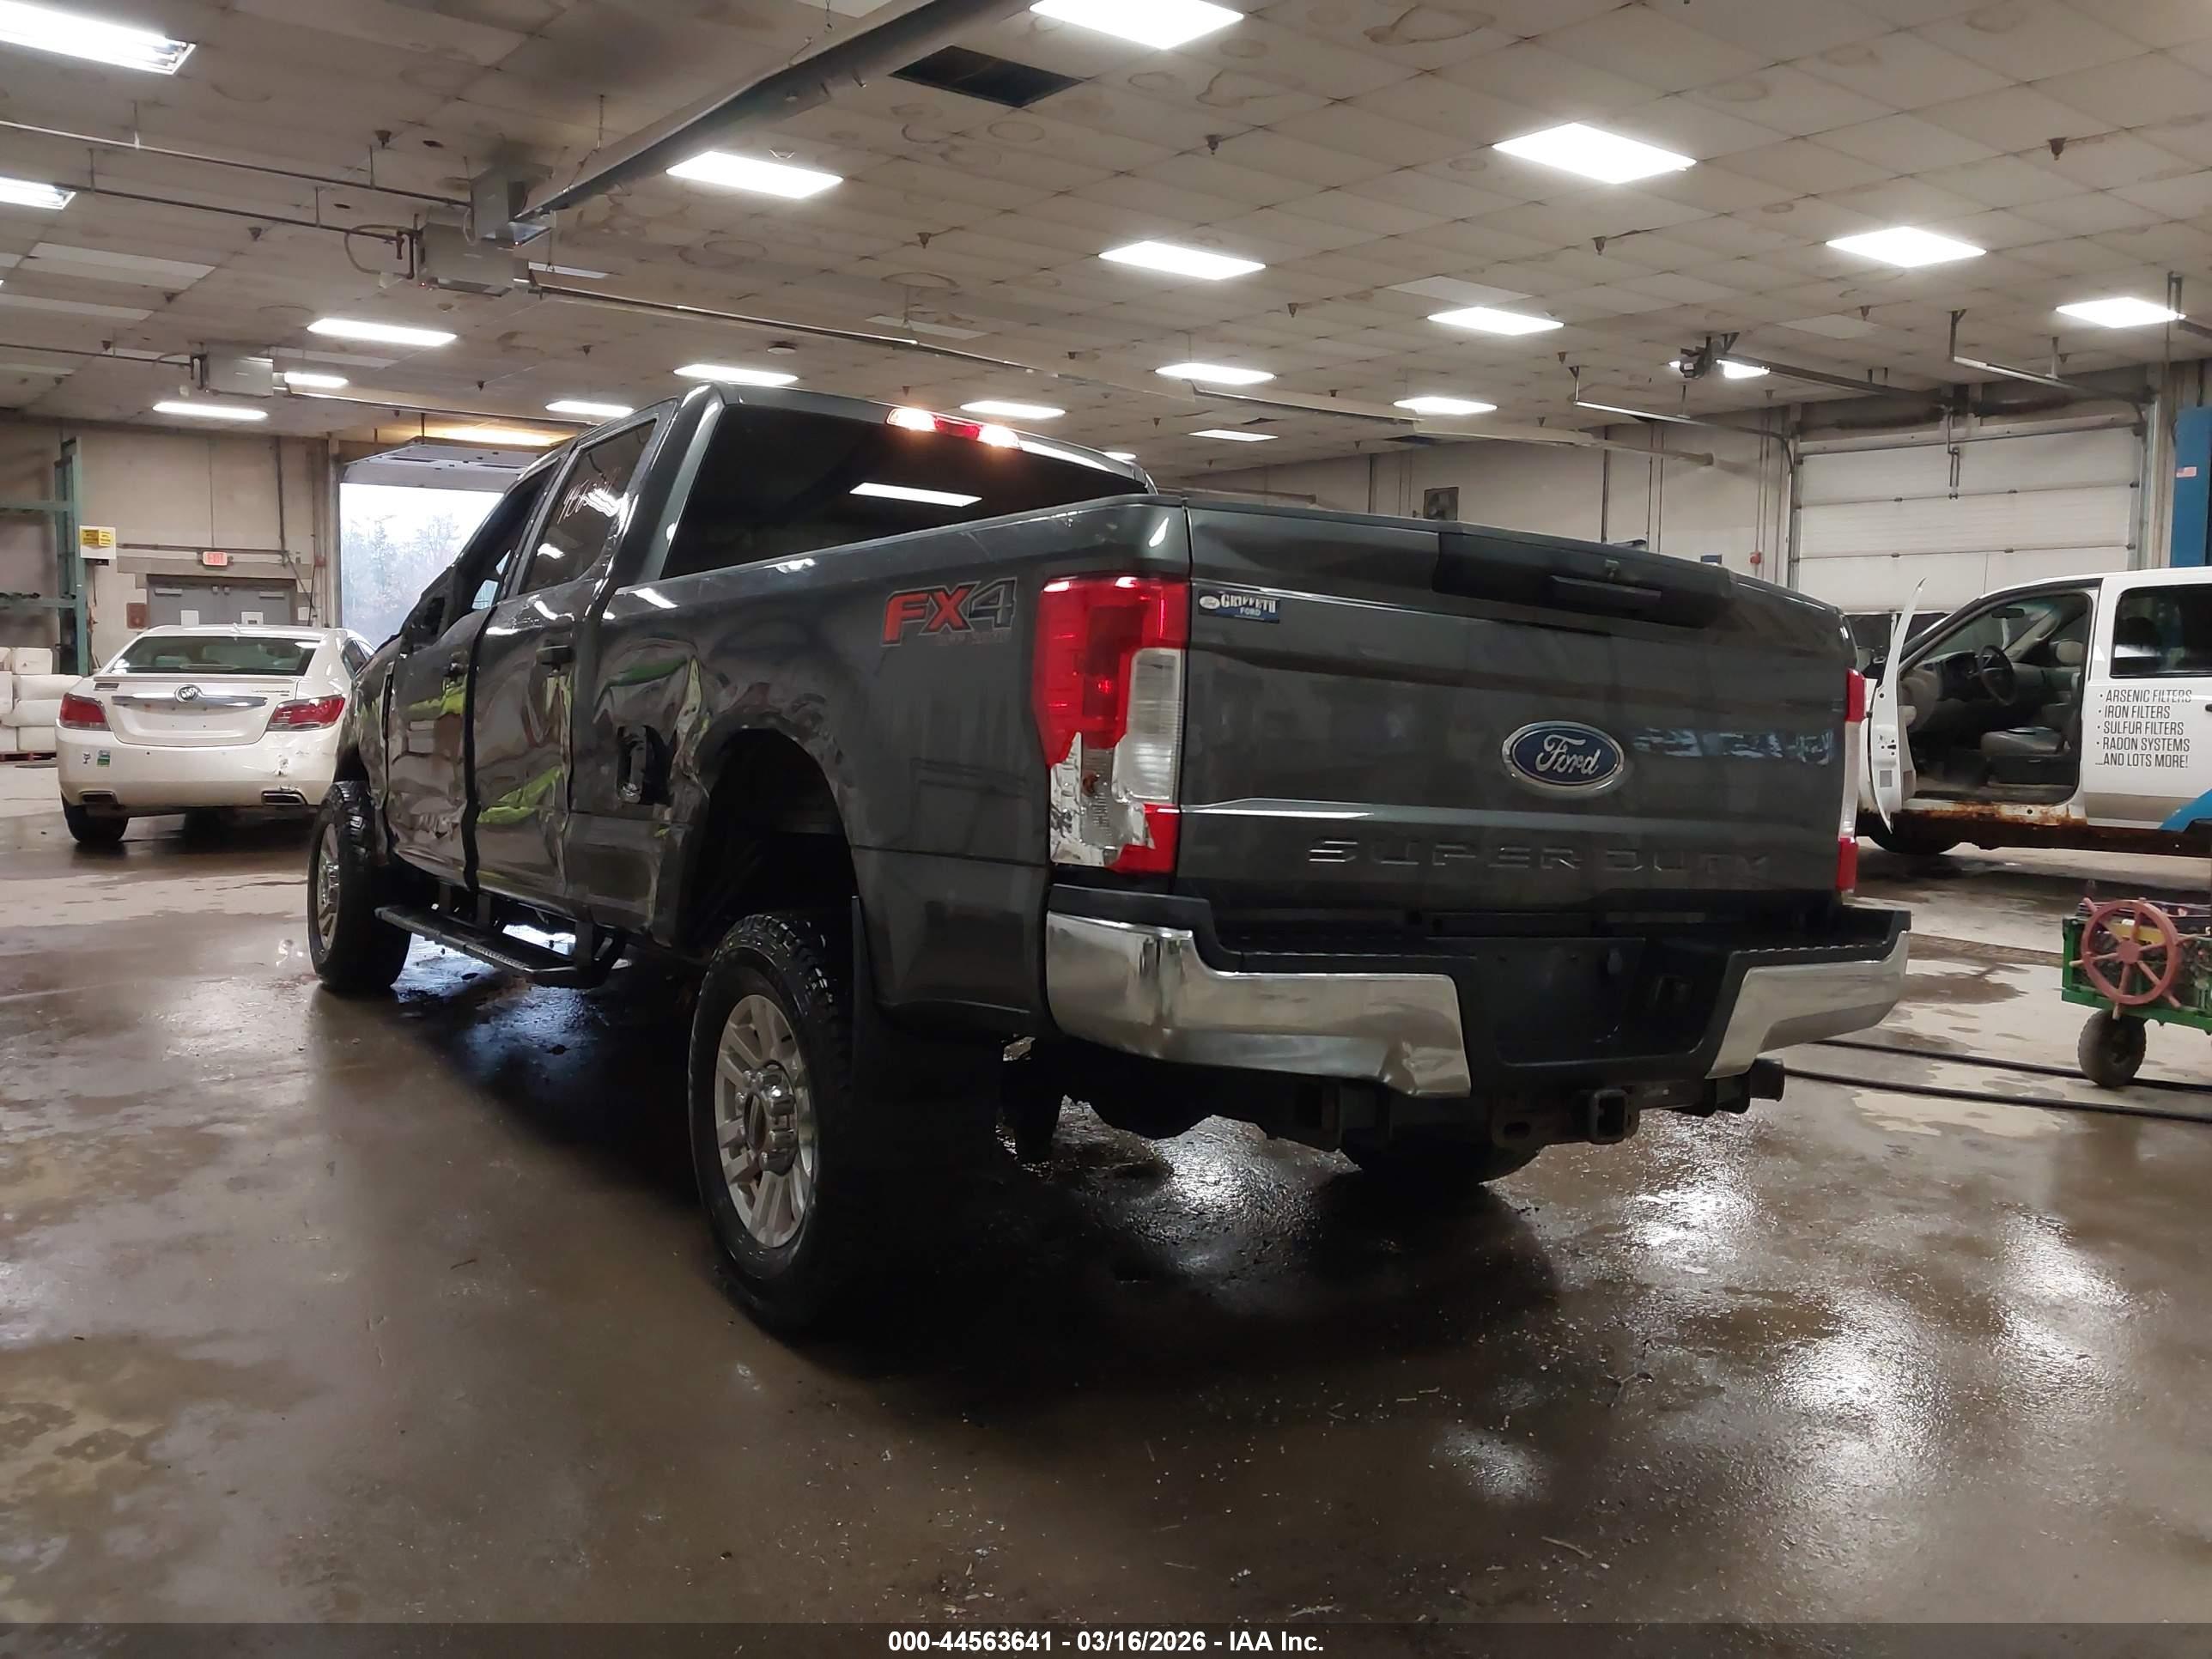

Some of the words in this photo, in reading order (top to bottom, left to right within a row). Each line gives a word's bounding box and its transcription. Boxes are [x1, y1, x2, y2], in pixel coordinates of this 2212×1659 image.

[880, 577, 1017, 647] FX4
[1239, 606, 1261, 617] FORD
[2106, 690, 2150, 702] ARSENIC
[2152, 690, 2192, 702] FILTERS
[2104, 705, 2129, 718] IRON
[2131, 705, 2170, 719] FILTERS
[2103, 720, 2142, 734] SULFUR
[2144, 721, 2184, 735] FILTERS
[2102, 737, 2138, 750] RADON
[2141, 738, 2191, 751] SYSTEMS
[1534, 733, 1601, 775] Ford
[2126, 753, 2152, 767] LOTS
[2154, 754, 2189, 768] MORE!
[1307, 839, 1581, 870] SUPER
